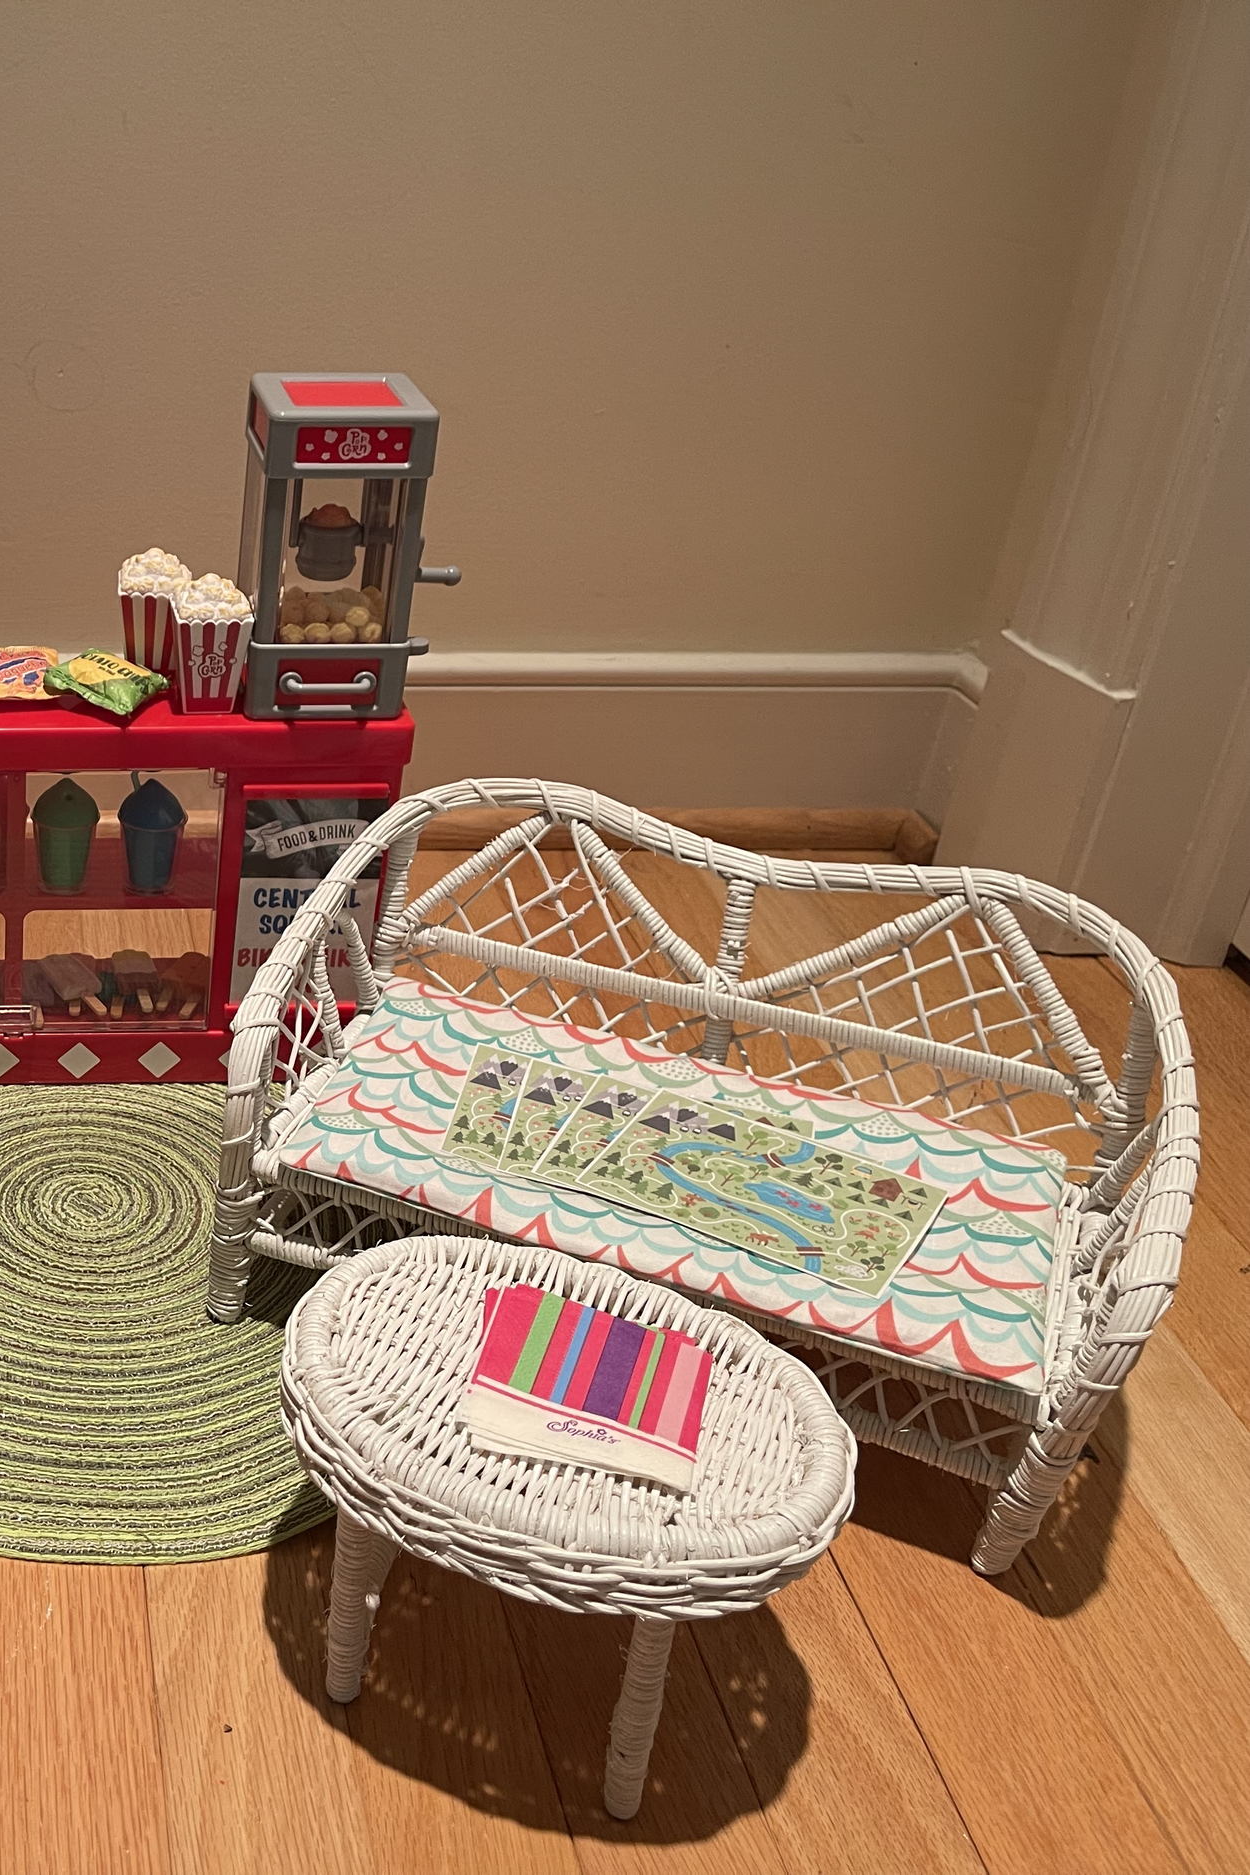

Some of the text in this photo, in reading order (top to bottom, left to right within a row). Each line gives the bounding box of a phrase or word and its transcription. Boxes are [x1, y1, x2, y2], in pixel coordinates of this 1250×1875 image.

[277, 823, 356, 852] FOOD & DRINK
[546, 1419, 622, 1445] Sophia's
